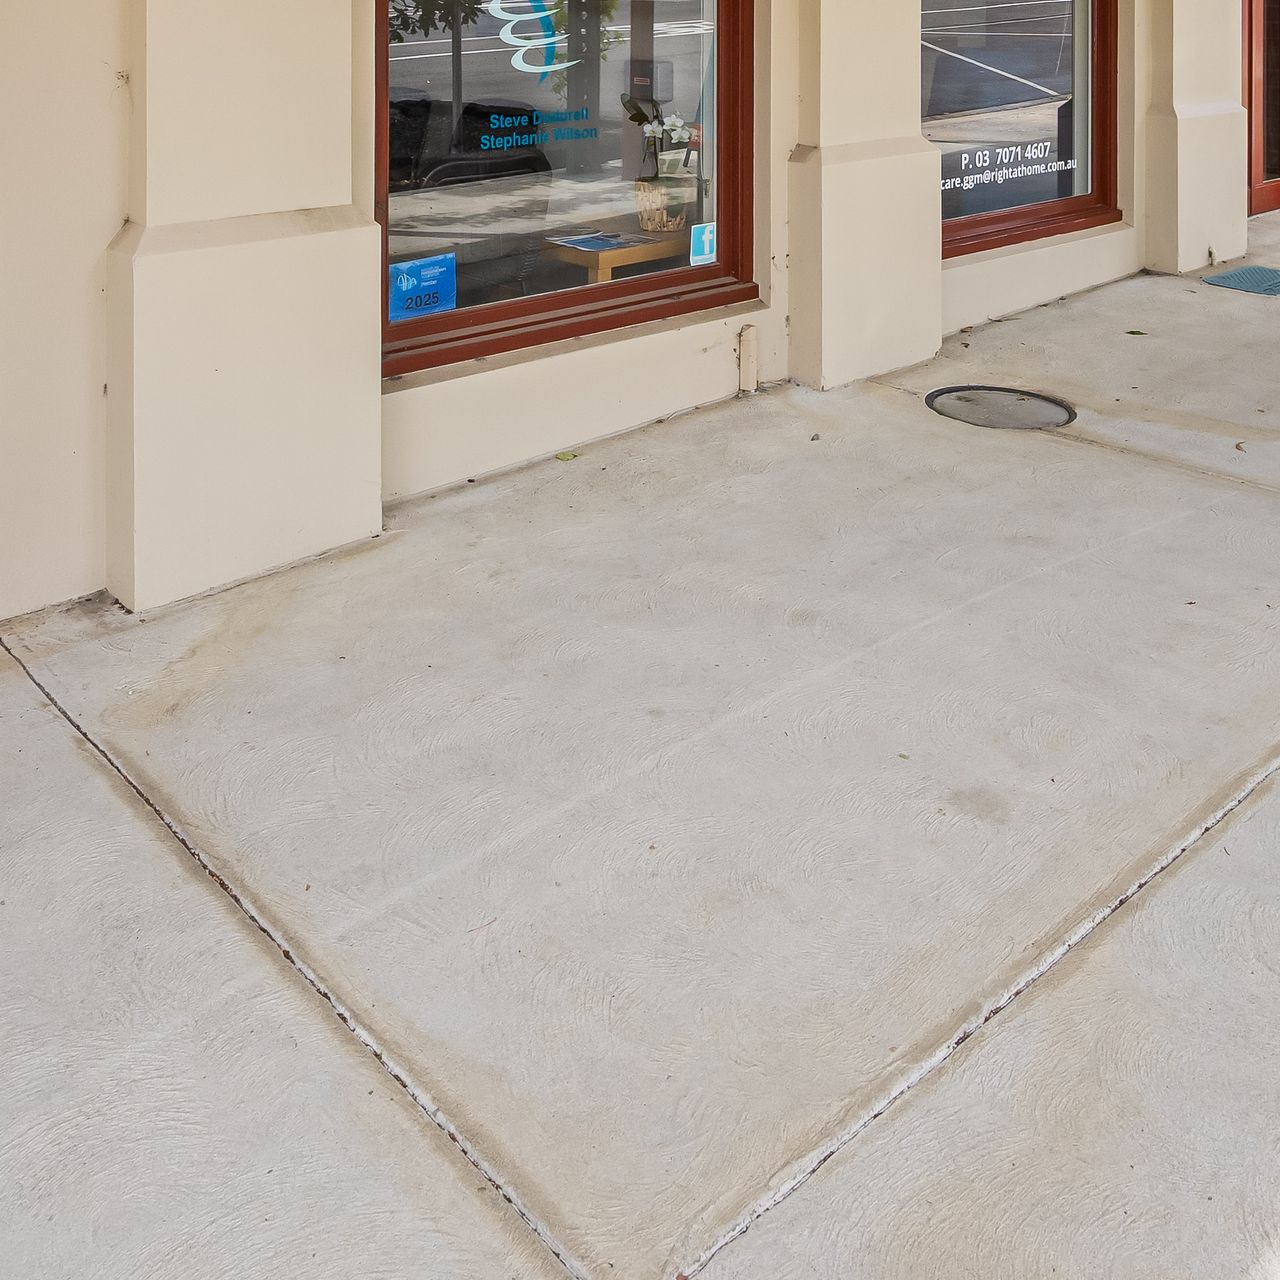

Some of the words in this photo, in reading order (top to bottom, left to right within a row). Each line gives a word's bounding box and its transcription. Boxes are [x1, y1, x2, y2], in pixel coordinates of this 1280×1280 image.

[490, 113, 529, 129] Steve
[480, 130, 549, 150] Stephanie
[552, 127, 598, 140] Wilson
[961, 153, 973, 170] P.
[975, 150, 990, 167] 03
[995, 146, 1022, 164] 7071
[1024, 142, 1051, 159] 4607
[941, 159, 1077, 190] care.ggm@rightathome.com.au
[405, 291, 439, 310] 2025
